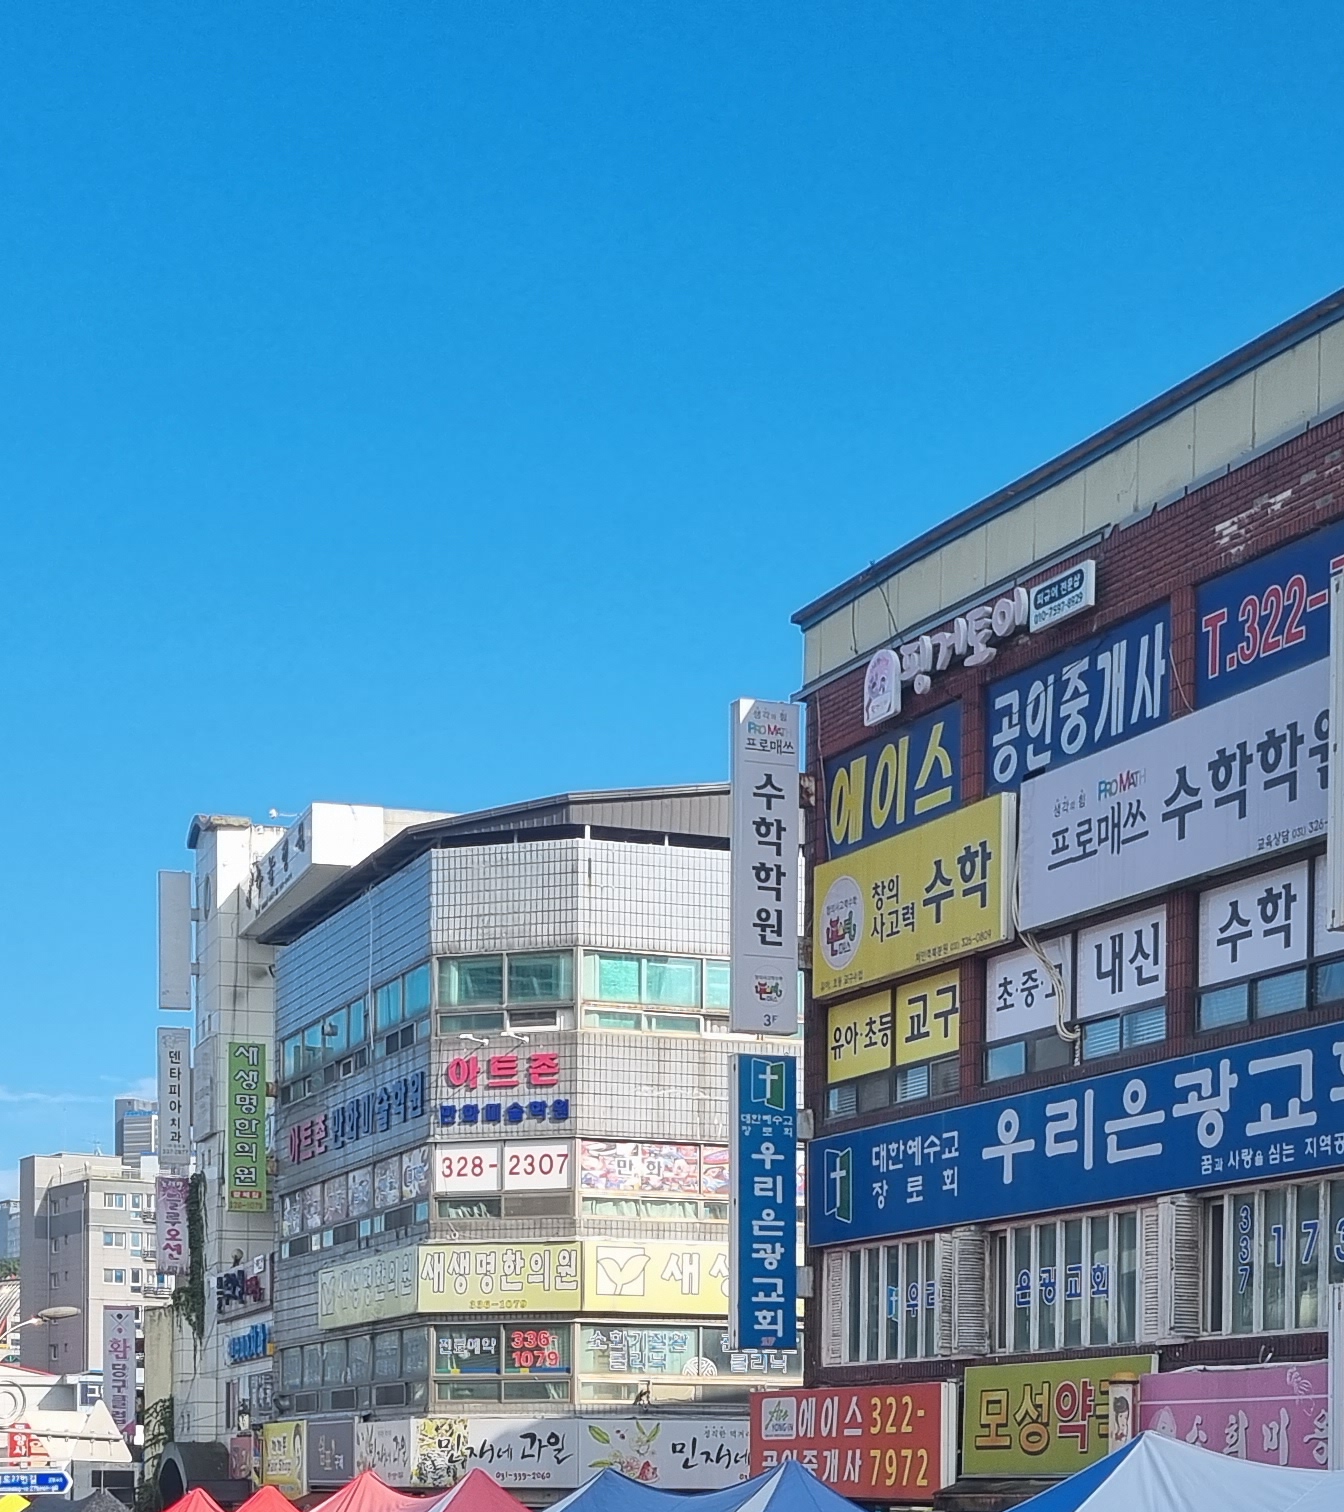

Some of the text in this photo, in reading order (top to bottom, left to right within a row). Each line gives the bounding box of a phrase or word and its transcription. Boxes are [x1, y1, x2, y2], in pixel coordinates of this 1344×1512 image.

[992, 622, 1166, 783] 공인중개사
[745, 738, 795, 756] 프로매쓰
[830, 721, 953, 845] 에이스
[1047, 799, 1149, 871] 프로매쓰
[752, 773, 786, 946] 수학학원
[871, 875, 900, 911] 창의
[922, 840, 992, 924] 수학
[870, 902, 916, 943] 사고력
[1217, 883, 1297, 962] 수학
[1095, 922, 1161, 995] 내신
[763, 1014, 778, 1027] 3F
[830, 985, 960, 1058] 유아·초등 교구
[447, 1052, 560, 1089] 아트존
[168, 1050, 183, 1144] 덴타피아치과
[234, 1046, 260, 1187] 새생명한의원
[288, 1071, 427, 1165] 아트존 만화미술학원
[440, 1099, 570, 1124] 만화미술학원
[442, 1153, 569, 1178] 328- 2307
[872, 1130, 960, 1173] 대한예수교
[1268, 1142, 1295, 1165] 심는
[751, 1141, 785, 1338] 우리은광교회
[421, 1248, 578, 1294] 새생명한의원
[512, 1350, 560, 1368] 1079
[730, 1353, 789, 1374] 클리닉
[798, 1395, 926, 1438] 에이스 322-
[519, 1431, 574, 1463] 과일
[870, 1447, 930, 1487] 7972
